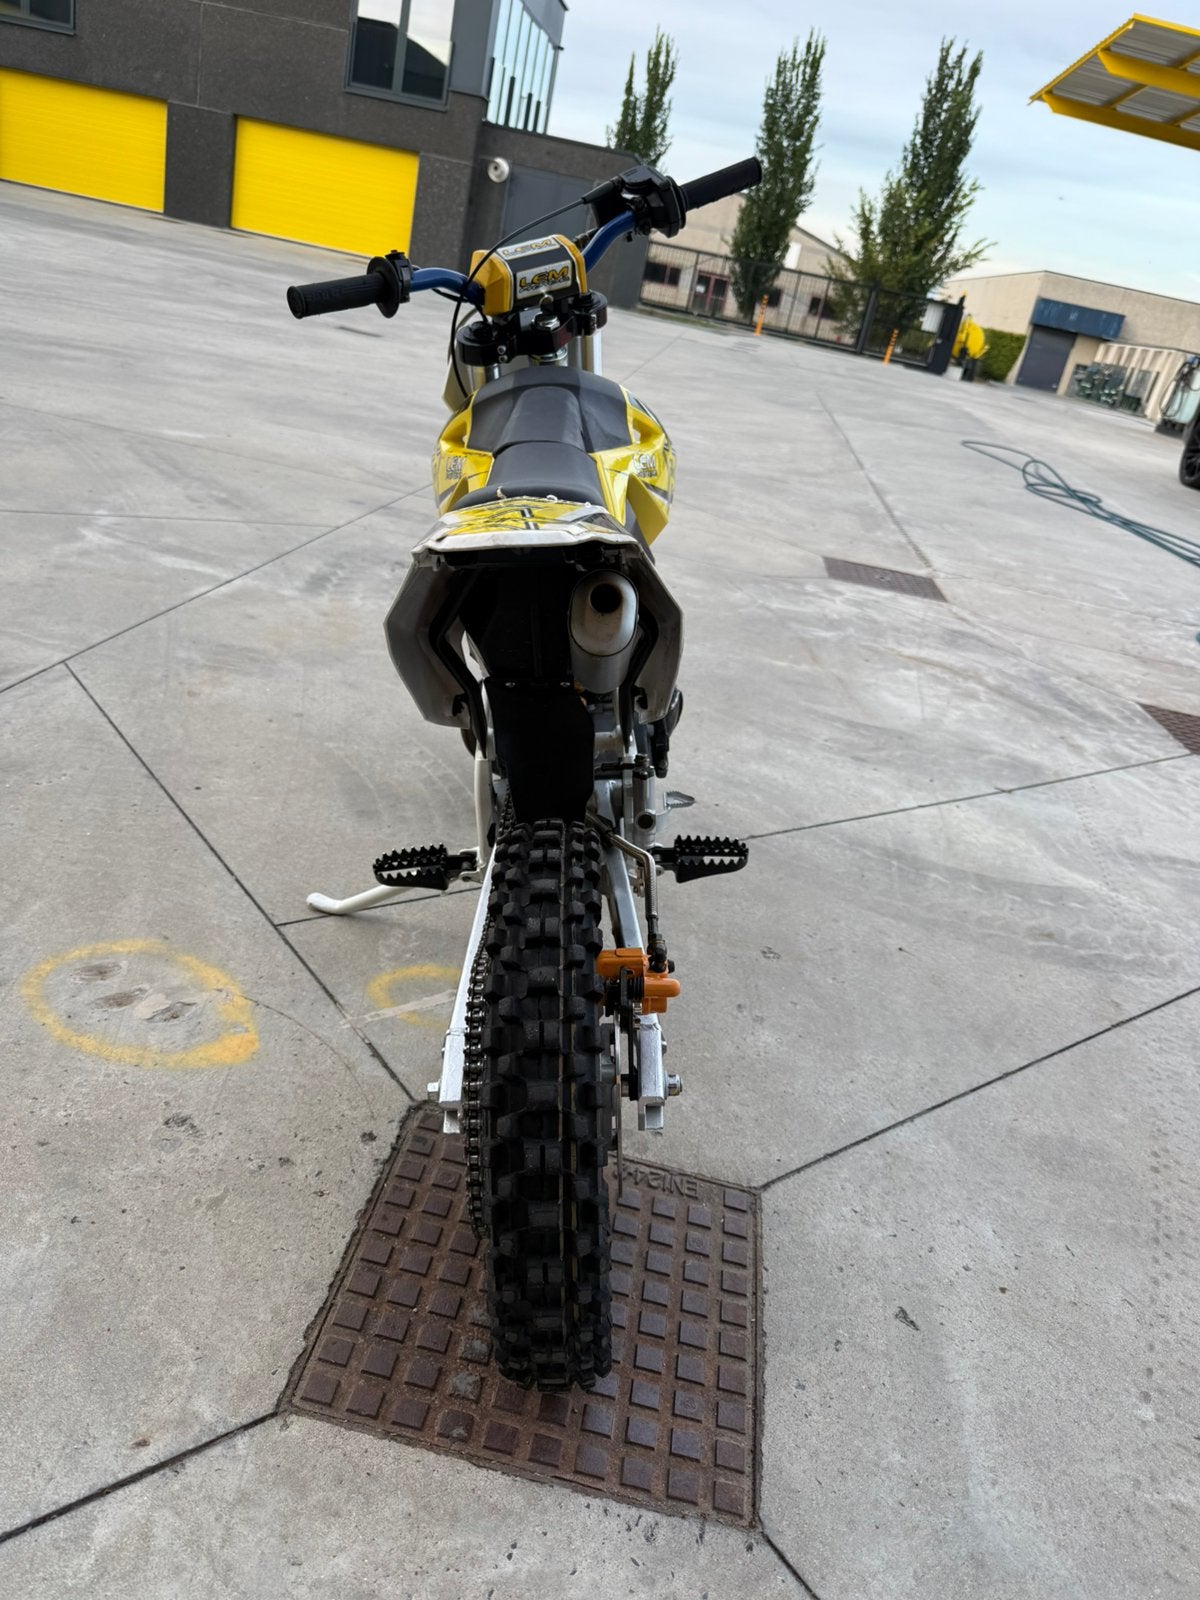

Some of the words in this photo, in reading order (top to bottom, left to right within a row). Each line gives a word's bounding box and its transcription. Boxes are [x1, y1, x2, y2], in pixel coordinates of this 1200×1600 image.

[503, 239, 552, 256] LEM
[519, 265, 569, 289] LEM
[632, 453, 656, 469] LEM
